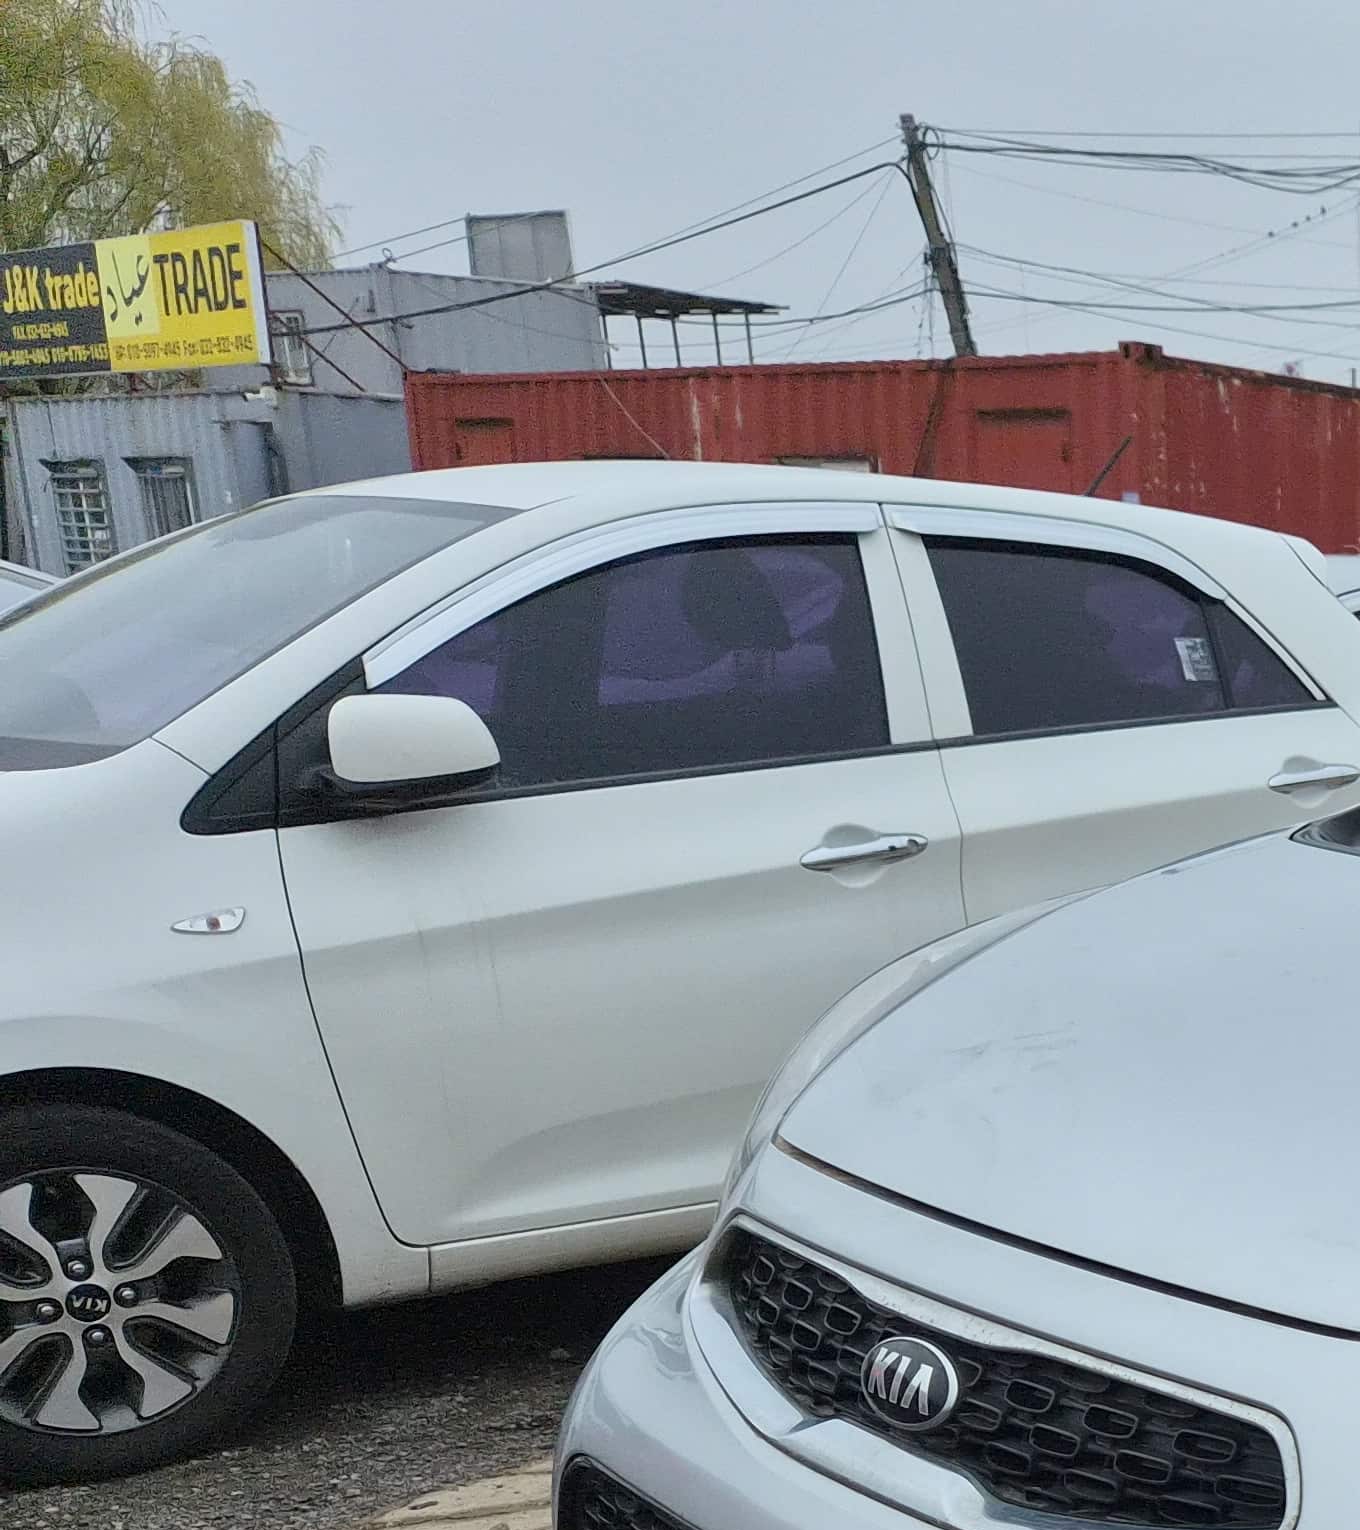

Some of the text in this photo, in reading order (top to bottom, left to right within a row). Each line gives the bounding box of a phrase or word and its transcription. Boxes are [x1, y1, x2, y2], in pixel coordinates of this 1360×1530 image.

[3, 260, 100, 314] J&K trade
[153, 243, 247, 316] TRADE
[867, 1346, 934, 1416] KIA
